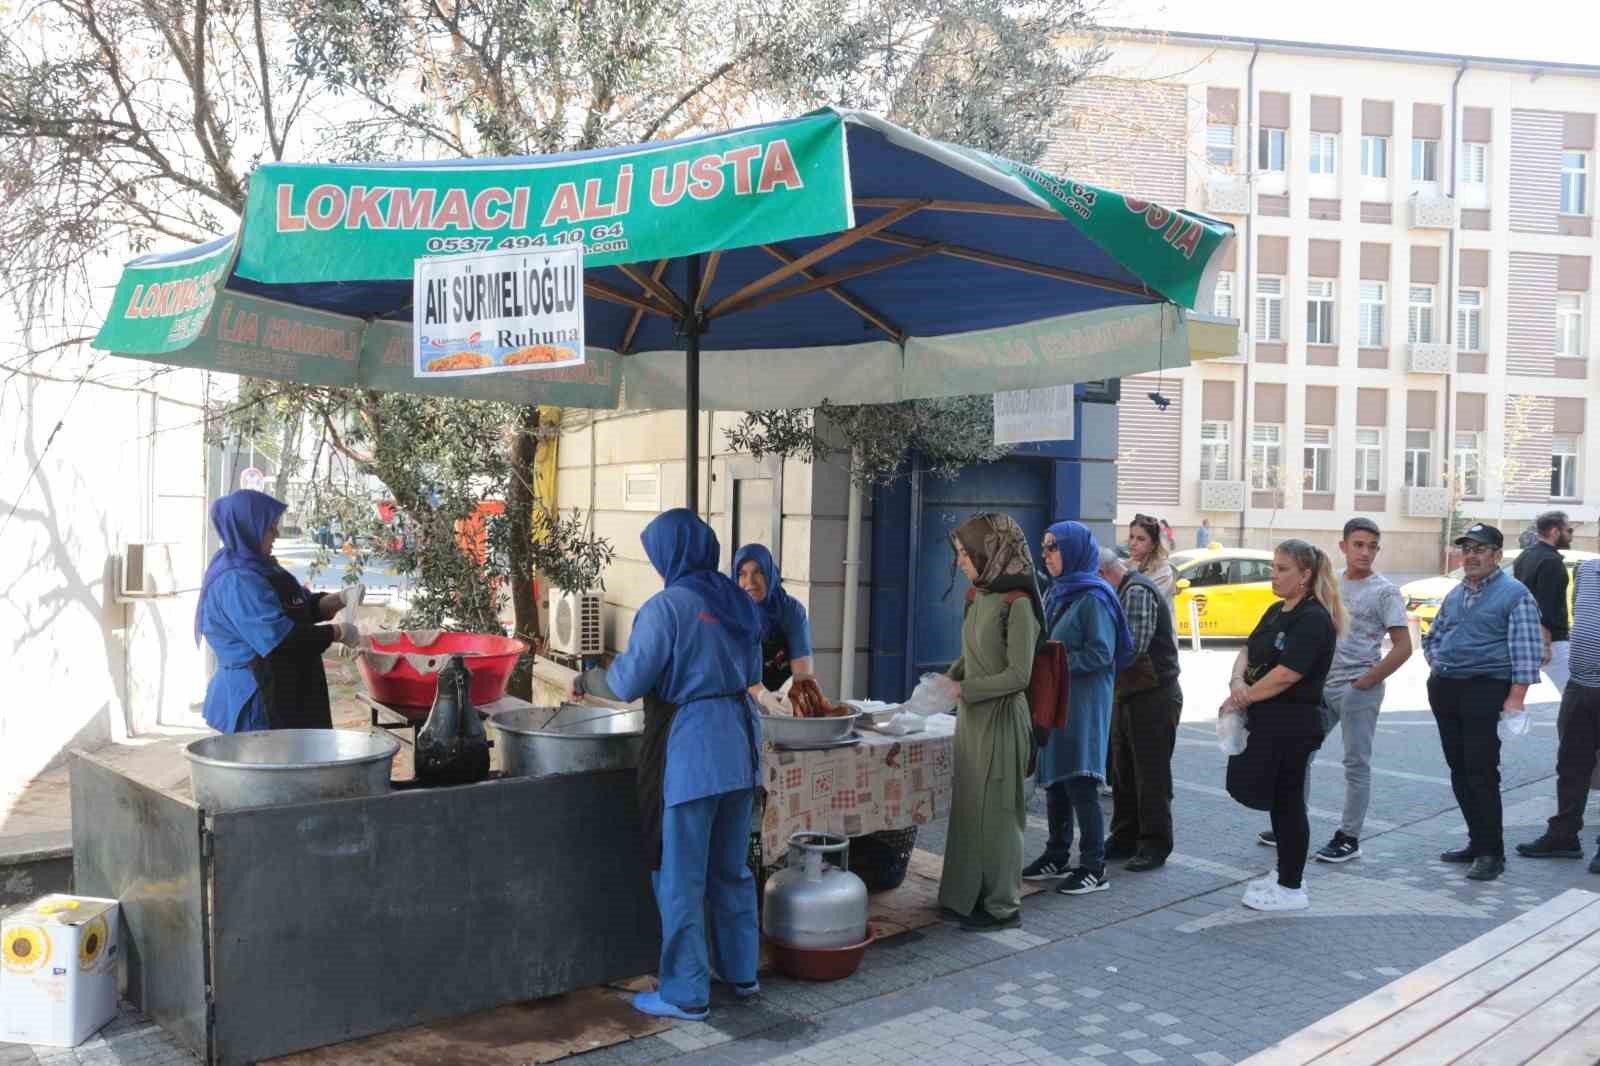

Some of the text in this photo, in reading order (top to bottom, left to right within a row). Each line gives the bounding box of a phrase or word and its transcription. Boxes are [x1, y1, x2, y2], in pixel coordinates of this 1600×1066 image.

[276, 139, 804, 233] LOKMACI ALİ USTA
[427, 221, 624, 252] 0537 494 10 64
[424, 257, 577, 326] Ali SÜRMELİOĞLU
[496, 327, 580, 348] Ruhuna
